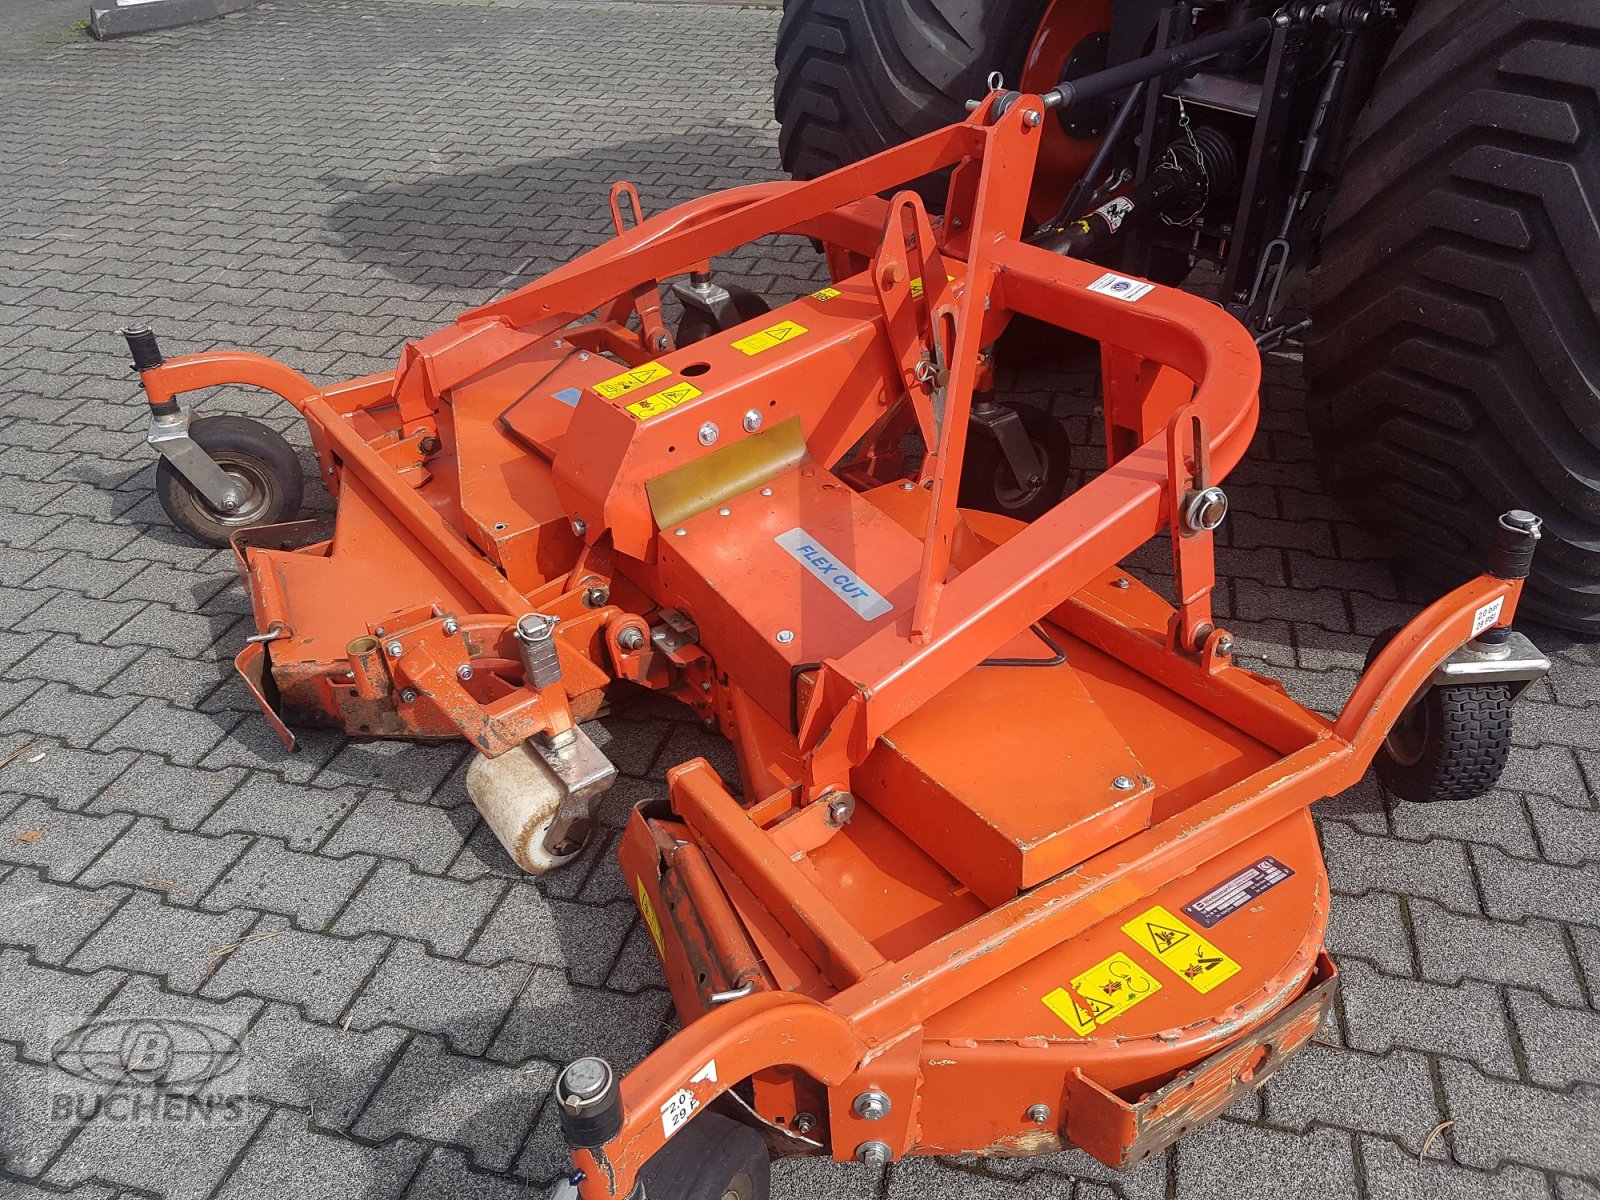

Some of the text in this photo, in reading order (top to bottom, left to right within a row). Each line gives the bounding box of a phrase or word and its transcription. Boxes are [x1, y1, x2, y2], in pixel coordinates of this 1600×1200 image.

[796, 545, 869, 598] FLEX CUT
[669, 1094, 686, 1114] 2.0
[671, 1108, 687, 1126] 29
